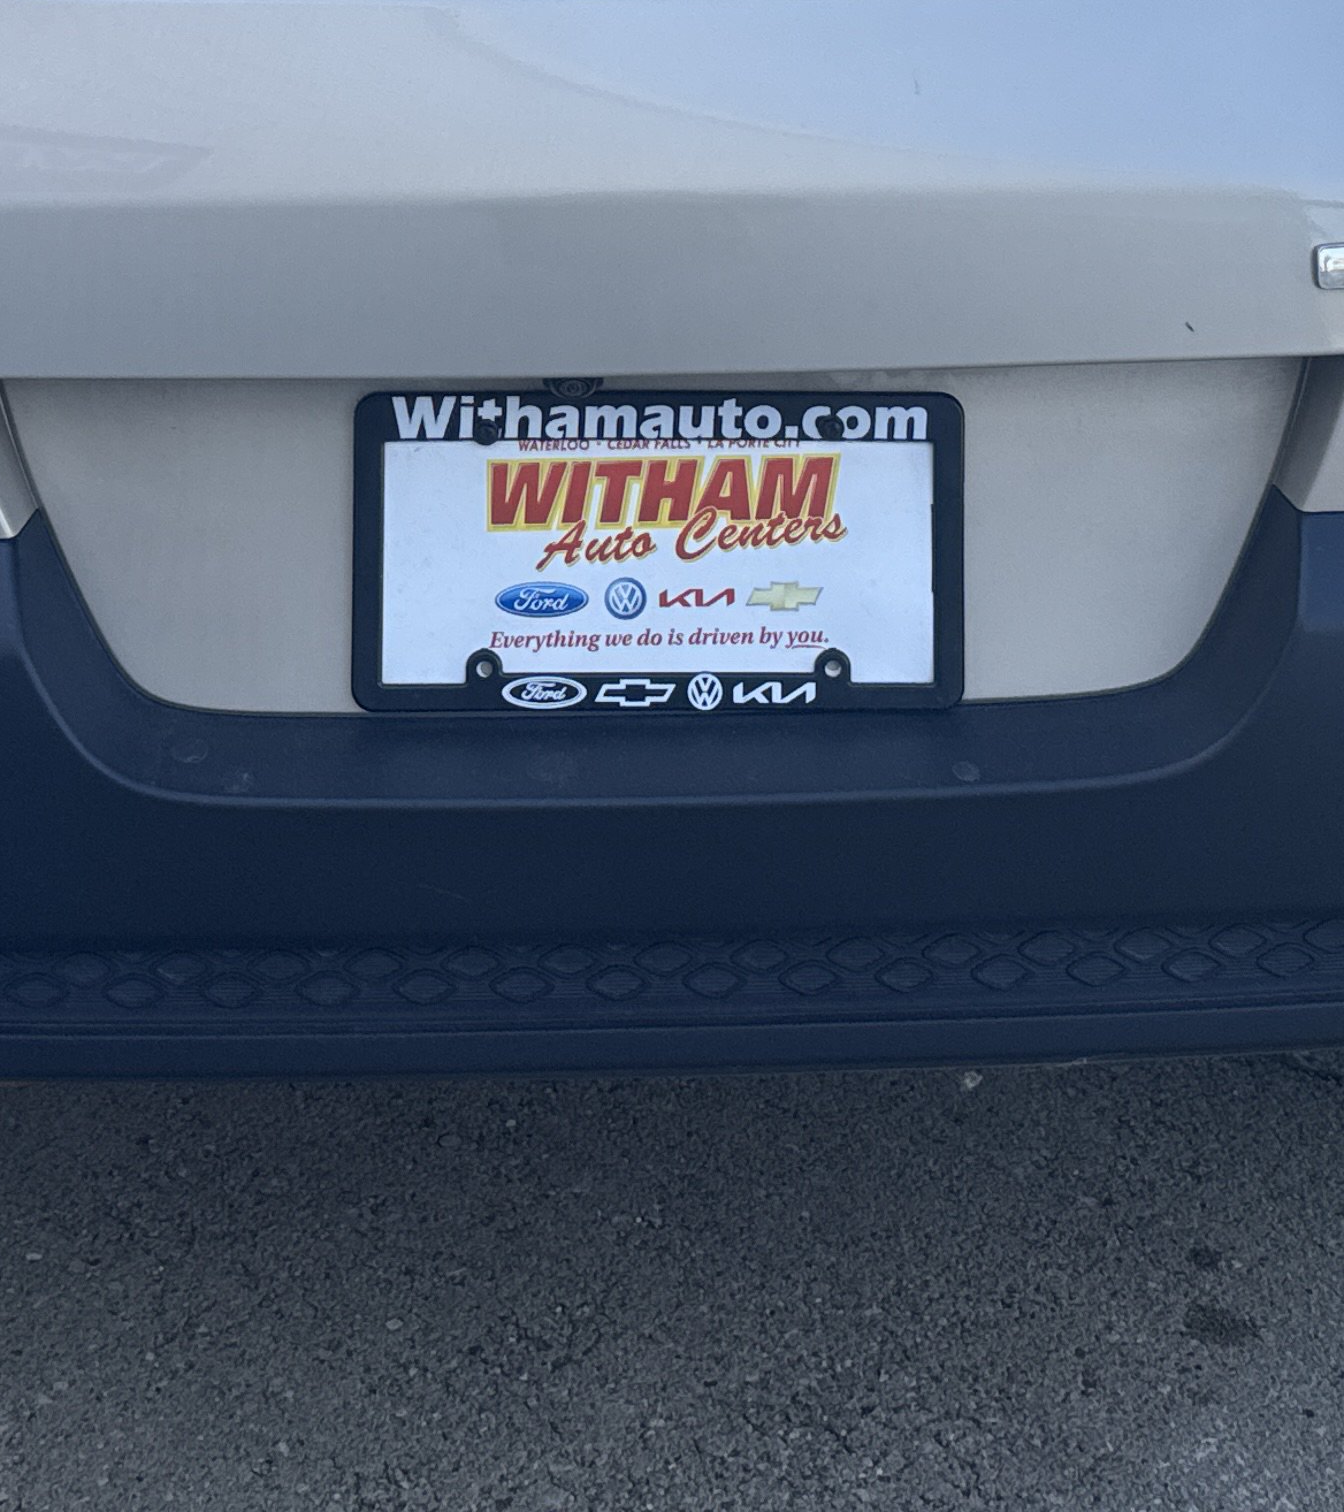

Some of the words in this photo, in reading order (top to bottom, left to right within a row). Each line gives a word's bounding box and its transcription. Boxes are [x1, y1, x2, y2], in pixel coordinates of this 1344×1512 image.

[391, 395, 928, 440] Withamauto.com
[518, 439, 590, 452] WATERLOO
[607, 439, 651, 451] CEDAR
[487, 454, 841, 531] WITHAM
[535, 520, 657, 572] Auto
[675, 506, 847, 562] Centers
[488, 629, 600, 653] Everything
[605, 632, 632, 647] we
[636, 628, 663, 647] do
[667, 628, 684, 646] is
[687, 627, 754, 646] driven
[759, 626, 782, 649] by
[785, 630, 830, 650] you.
